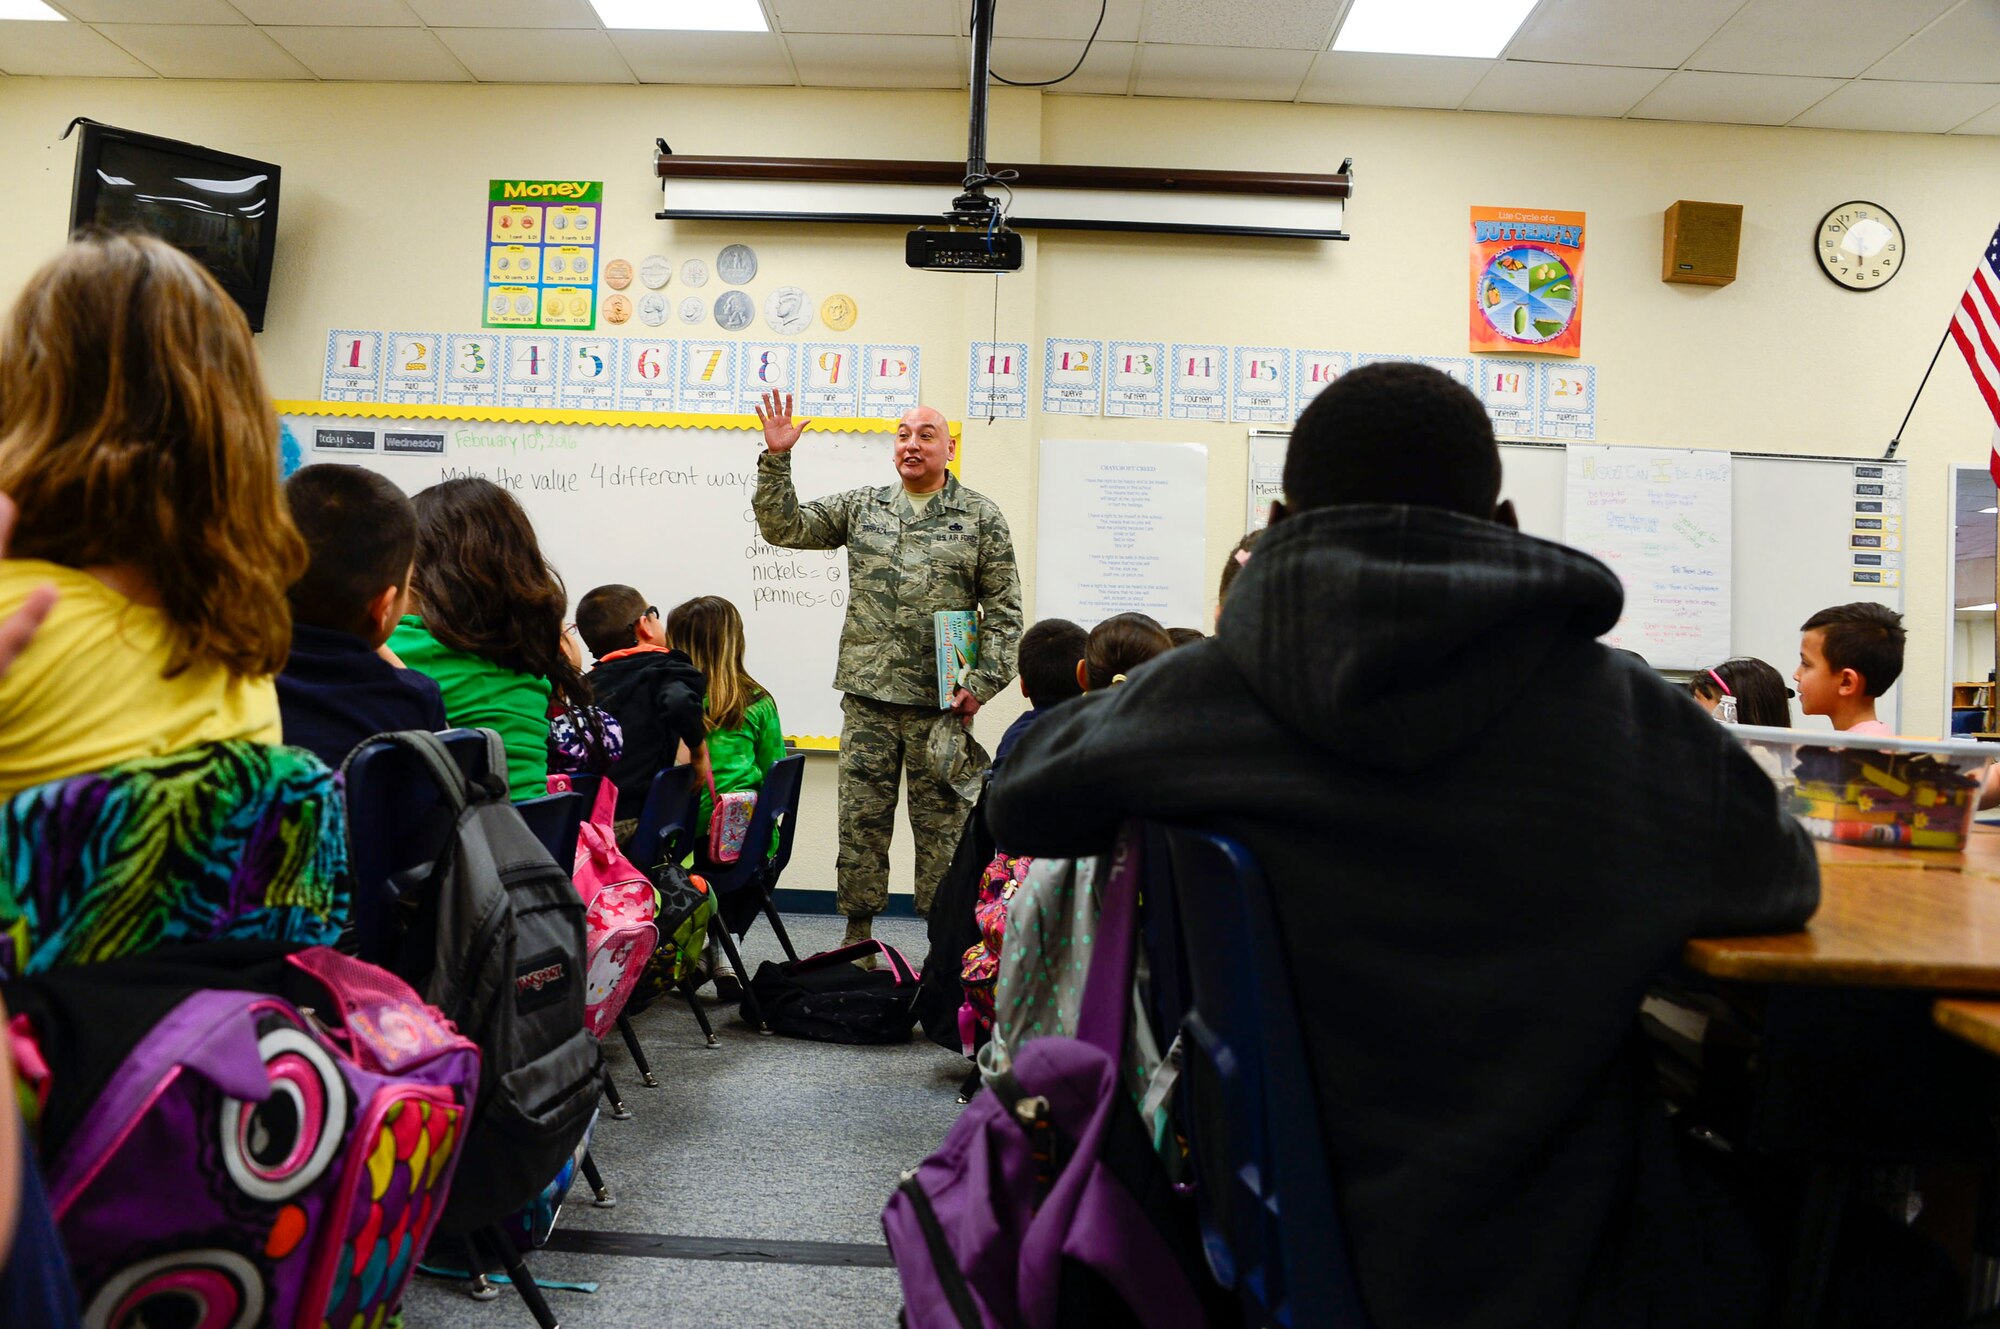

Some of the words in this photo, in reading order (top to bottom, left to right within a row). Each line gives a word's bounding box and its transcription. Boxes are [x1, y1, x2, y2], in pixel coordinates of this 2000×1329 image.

[504, 181, 591, 199] Money
[1498, 211, 1514, 220] Life
[1515, 212, 1539, 221] Cycle
[1854, 211, 1867, 219] 12
[1474, 220, 1584, 249] BUTTERFLY
[1826, 240, 1834, 248] 9
[1830, 255, 1838, 263] 8
[1841, 267, 1849, 275] 7
[1856, 272, 1864, 280] 6
[1872, 269, 1880, 277] 5
[342, 340, 367, 369] 1
[401, 342, 427, 371] 2
[460, 343, 486, 373] 3
[516, 345, 545, 375] 4
[578, 345, 604, 377] 5
[637, 348, 661, 380] 6
[1056, 350, 1090, 372] 12
[1119, 354, 1153, 375] 13
[695, 349, 723, 382] 7
[758, 350, 781, 384] 8
[818, 351, 842, 385] 9
[876, 358, 907, 378] 10
[984, 355, 1015, 376] 11
[1183, 356, 1216, 378] 14
[1246, 360, 1277, 382] 15
[1307, 363, 1339, 384] 16
[346, 380, 359, 388] one
[404, 381, 419, 389] two
[463, 383, 479, 392] three
[1491, 372, 1520, 393] 19
[1551, 377, 1583, 397] 20
[523, 385, 538, 393] four
[582, 386, 596, 394] five
[644, 389, 654, 397] six
[697, 390, 717, 398] seven
[1060, 389, 1083, 399] twelve
[823, 394, 836, 402] nine
[884, 394, 896, 403] ten
[987, 393, 1008, 402] eleven
[1123, 392, 1147, 401] thirteen
[1184, 395, 1213, 404] fourteen
[1250, 397, 1272, 406] fifteen
[319, 433, 343, 447] today
[385, 436, 443, 451] Wednesday
[455, 432, 517, 456] February
[547, 437, 577, 450] 2016
[497, 467, 522, 490] the
[531, 468, 578, 492] value
[590, 462, 605, 489] 4
[610, 465, 698, 488] different
[1856, 467, 1882, 477] Arrival
[1858, 485, 1881, 495] Math
[1856, 520, 1881, 530] Reading
[960, 535, 978, 543] FORCE
[1855, 537, 1878, 546] Lunch
